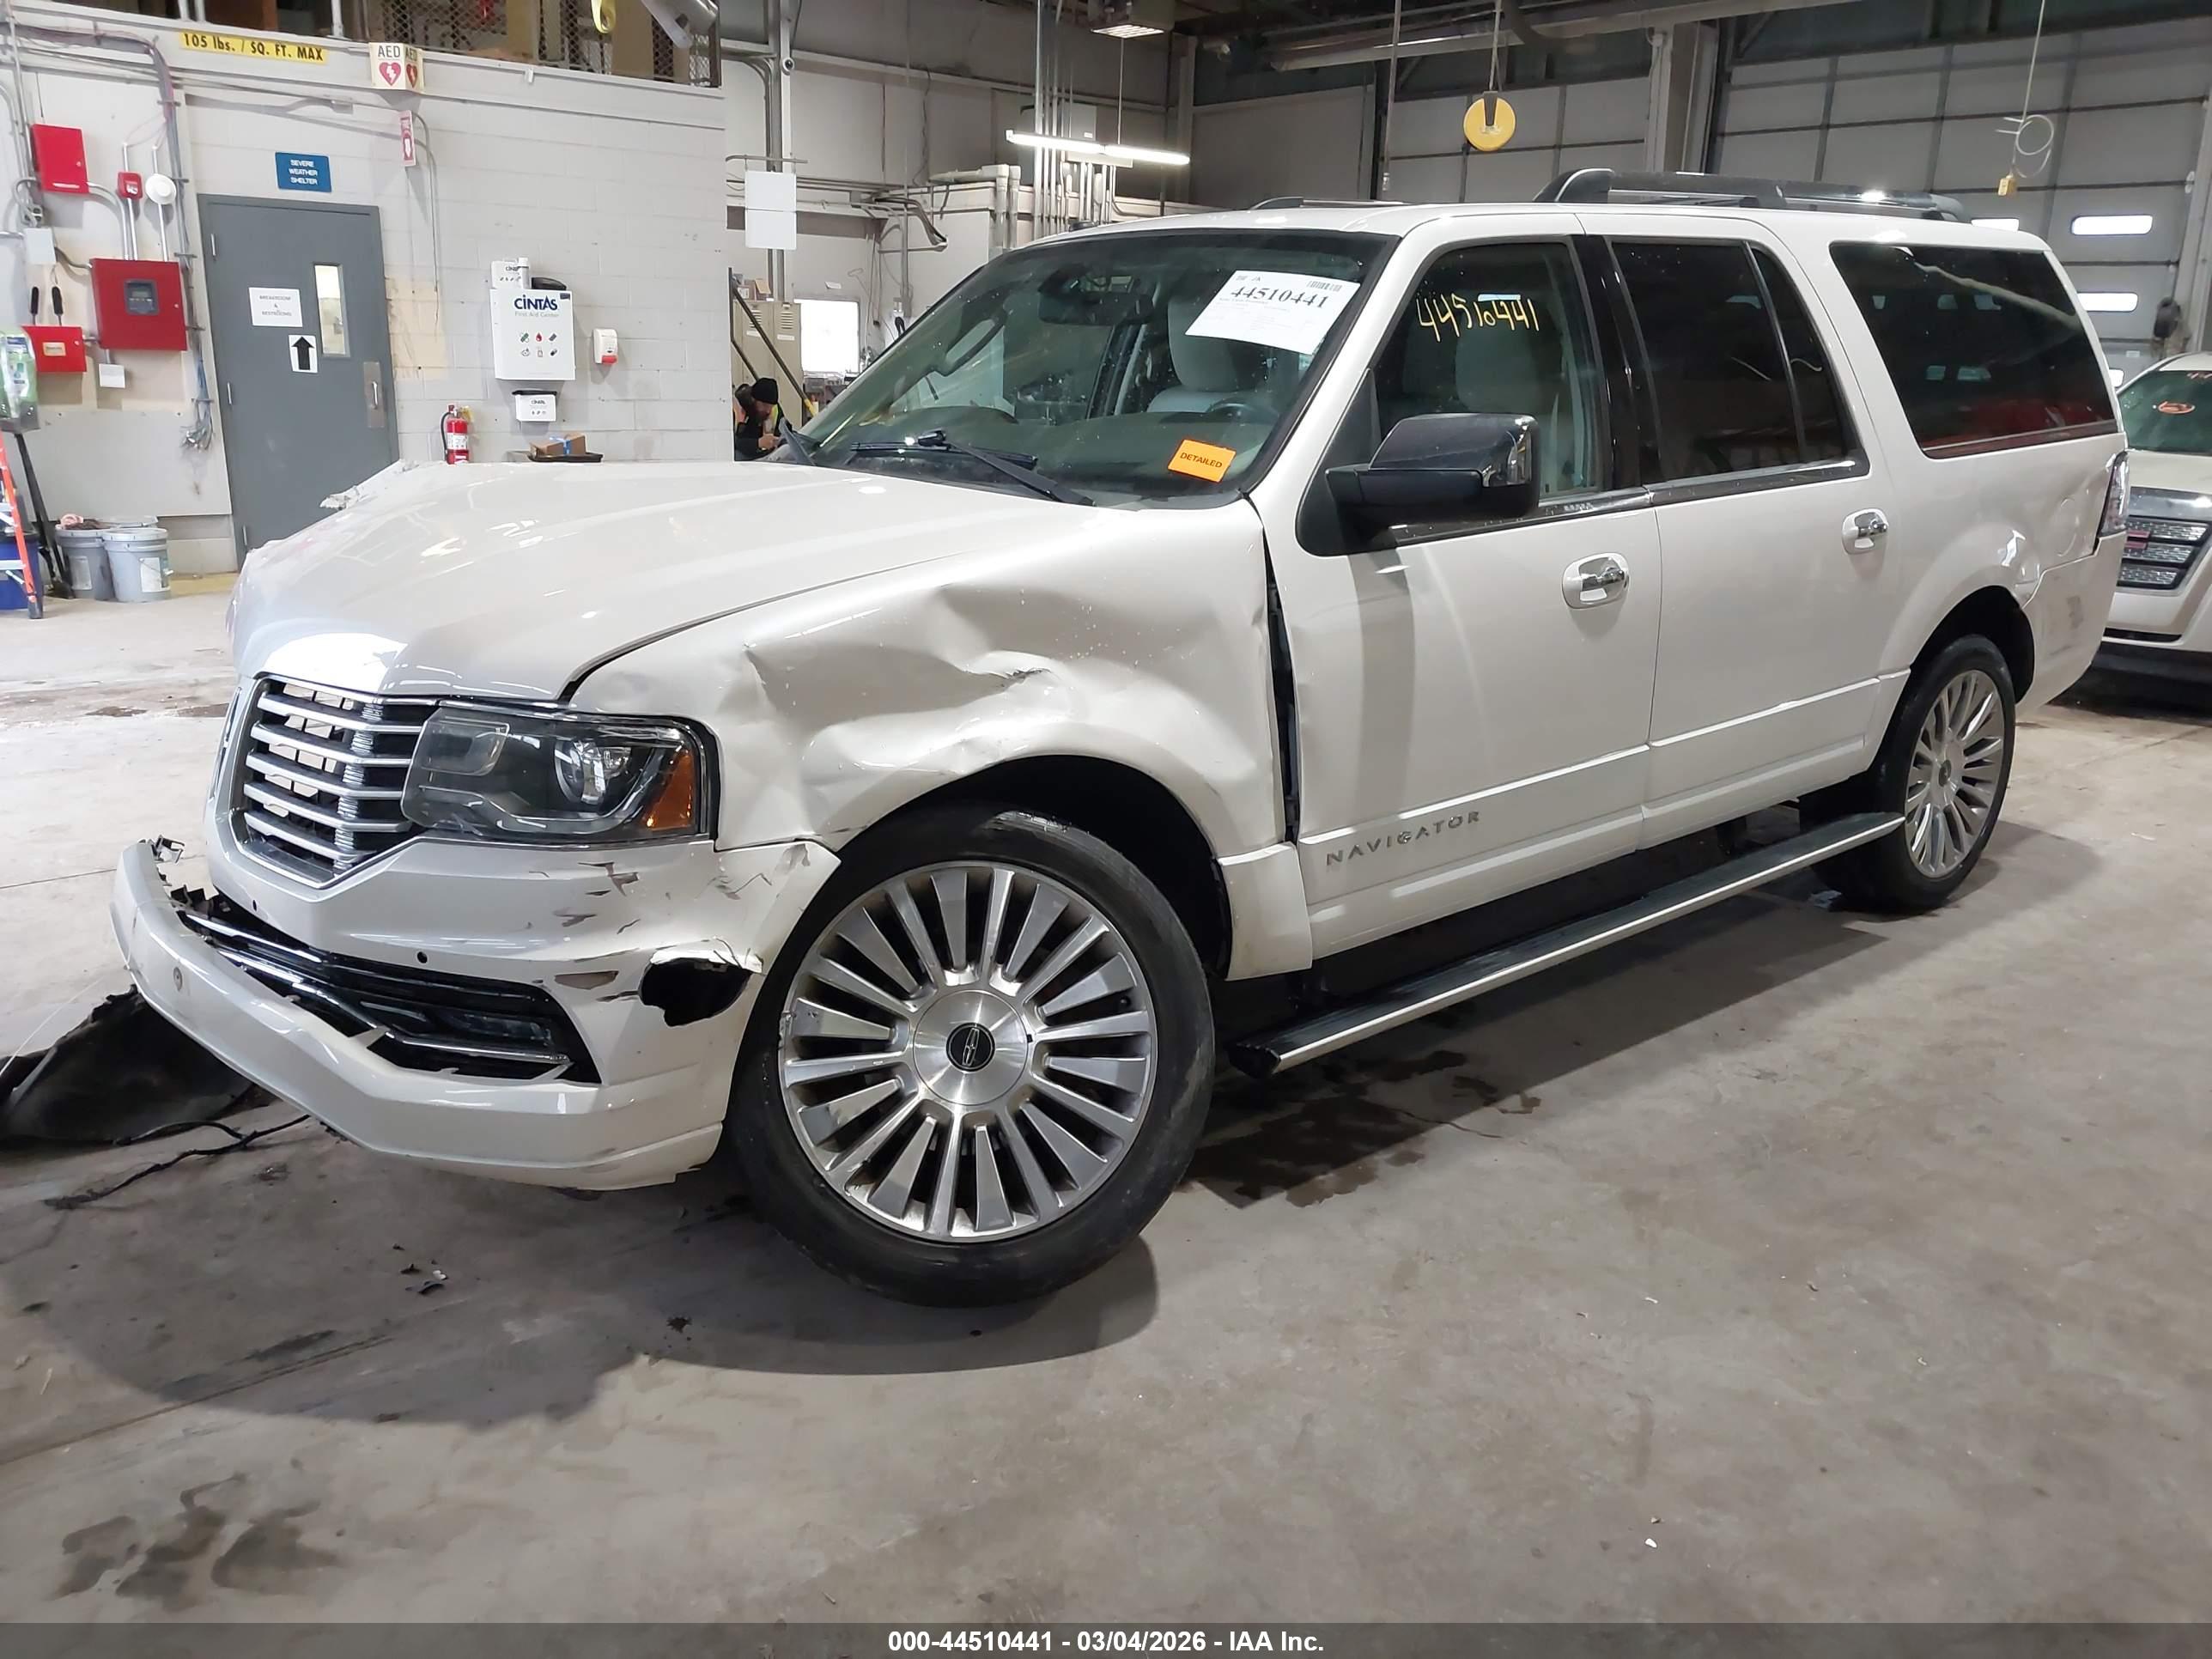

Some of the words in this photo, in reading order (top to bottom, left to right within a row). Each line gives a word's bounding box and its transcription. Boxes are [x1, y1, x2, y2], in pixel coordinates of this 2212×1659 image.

[183, 33, 208, 48] 105
[212, 35, 236, 52] lbs.
[240, 39, 246, 52] /
[251, 41, 270, 56] SQ.
[275, 44, 292, 58] FT.
[296, 46, 324, 61] MAX
[378, 45, 401, 58] AED
[405, 46, 418, 61] AED
[290, 159, 314, 167] SEVERE
[288, 167, 318, 176] WEATHER
[290, 176, 318, 185] SHELTER
[1231, 286, 1329, 309] 44510441
[1416, 293, 1540, 342] 44510441
[1180, 452, 1223, 468] DETAILED
[1326, 811, 1480, 866] NAVIGATOR
